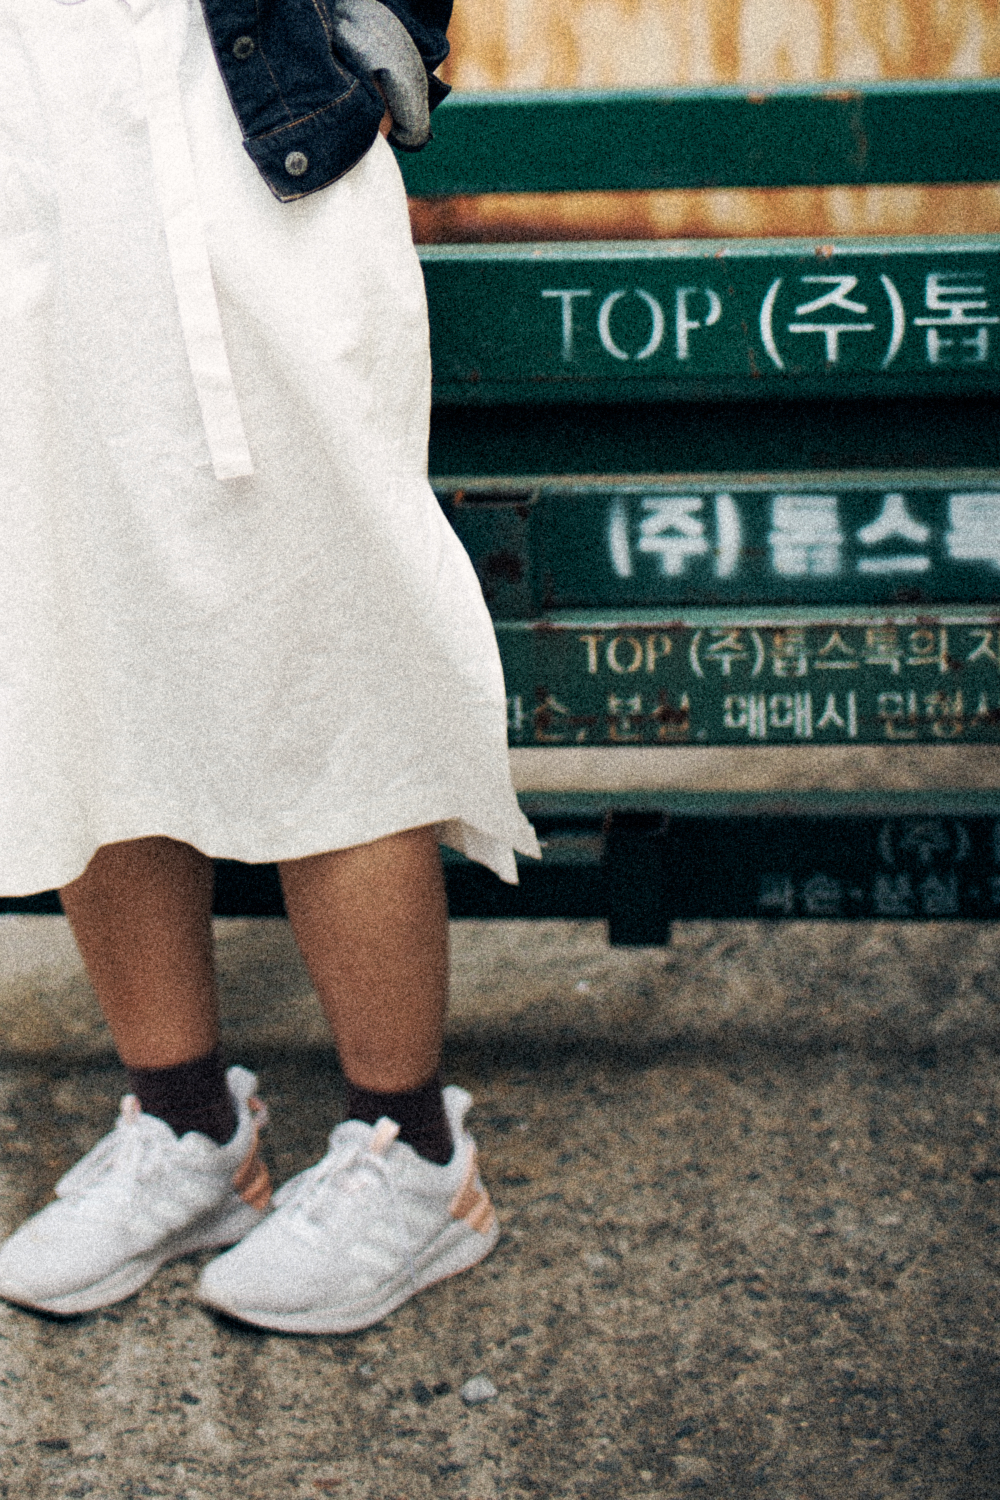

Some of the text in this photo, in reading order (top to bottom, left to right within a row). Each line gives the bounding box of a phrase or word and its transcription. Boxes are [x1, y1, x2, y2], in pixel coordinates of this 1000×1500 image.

[541, 287, 722, 361] TOP
[579, 634, 672, 674] TOP
[723, 691, 858, 740] 매매시
